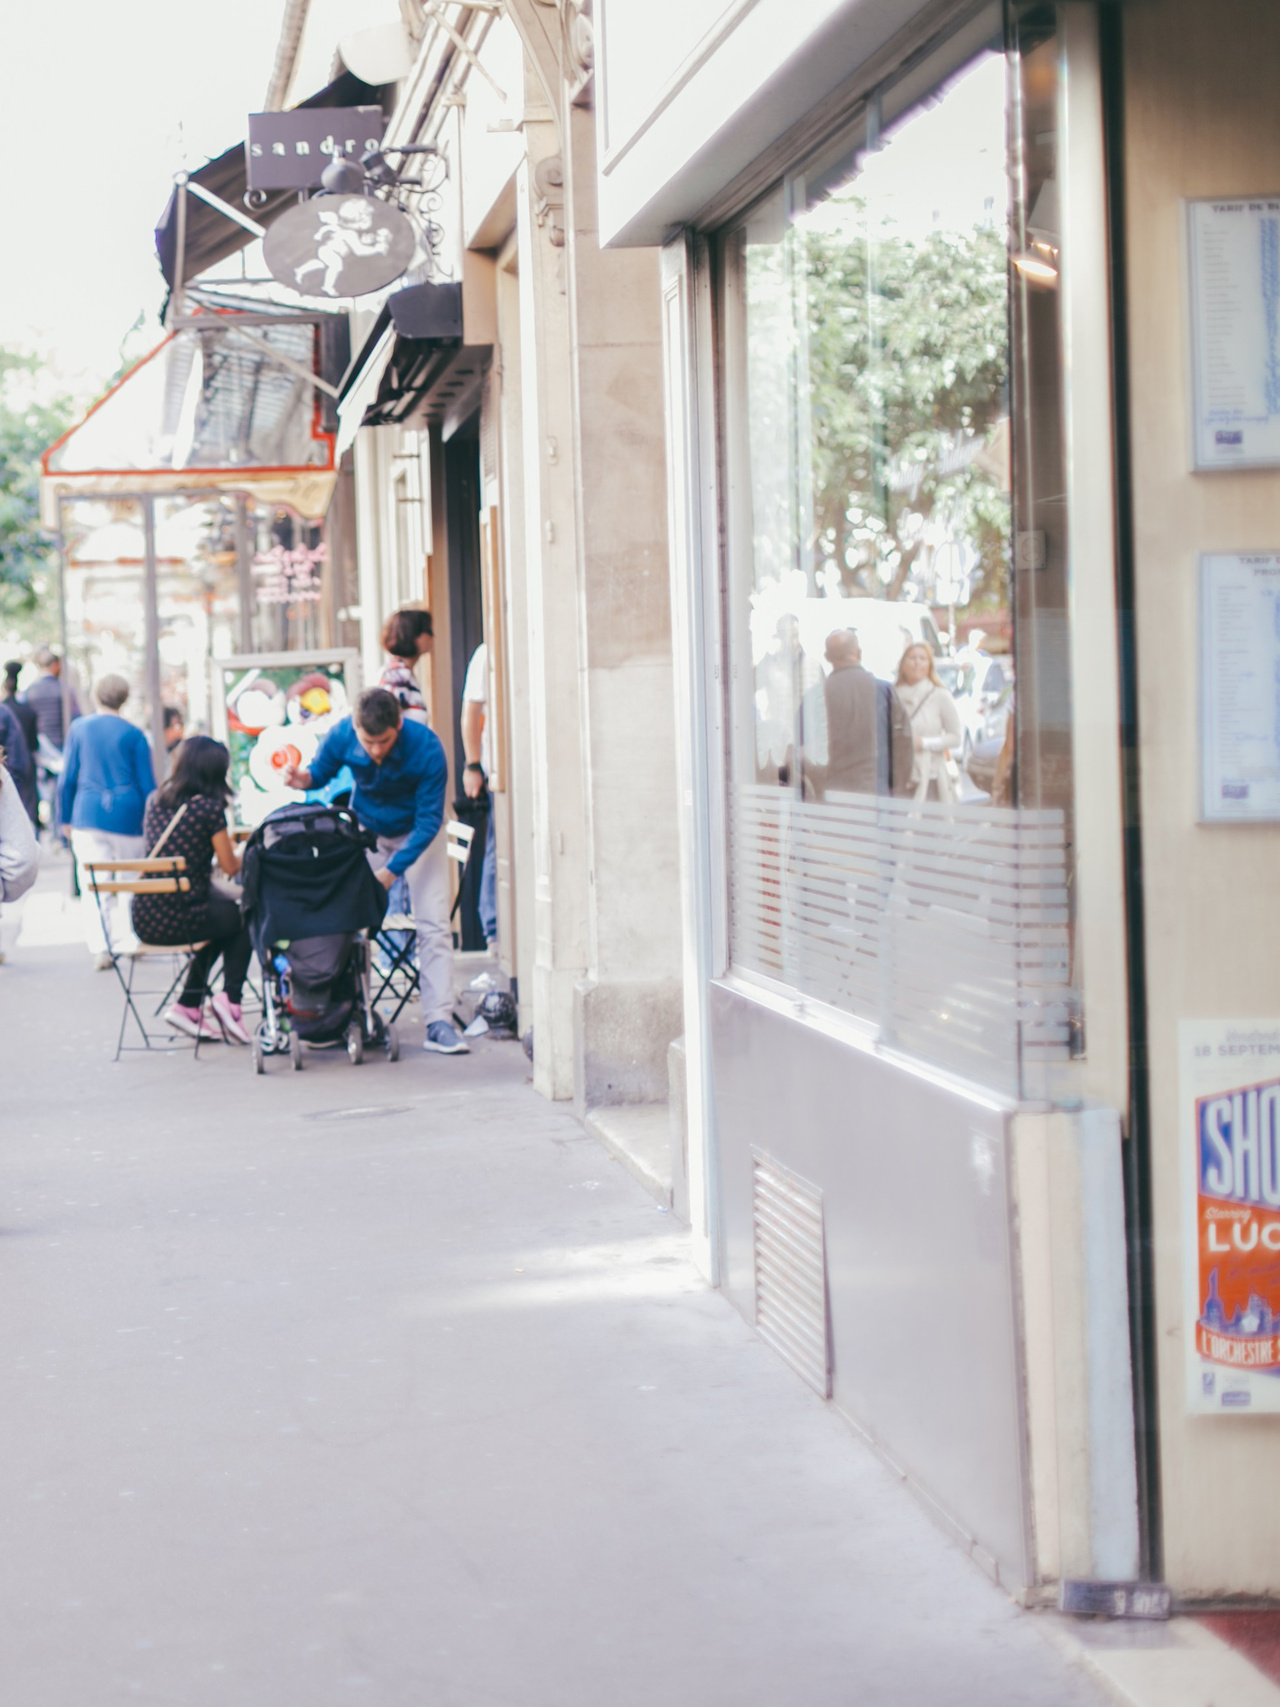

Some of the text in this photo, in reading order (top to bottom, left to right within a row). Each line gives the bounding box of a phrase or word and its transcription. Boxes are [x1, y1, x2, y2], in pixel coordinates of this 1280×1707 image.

[250, 135, 380, 157] sandro
[1194, 1045, 1212, 1057] 18
[1206, 1207, 1252, 1224] Starring
[1202, 1330, 1272, 1365] L'ORCHESTRE
